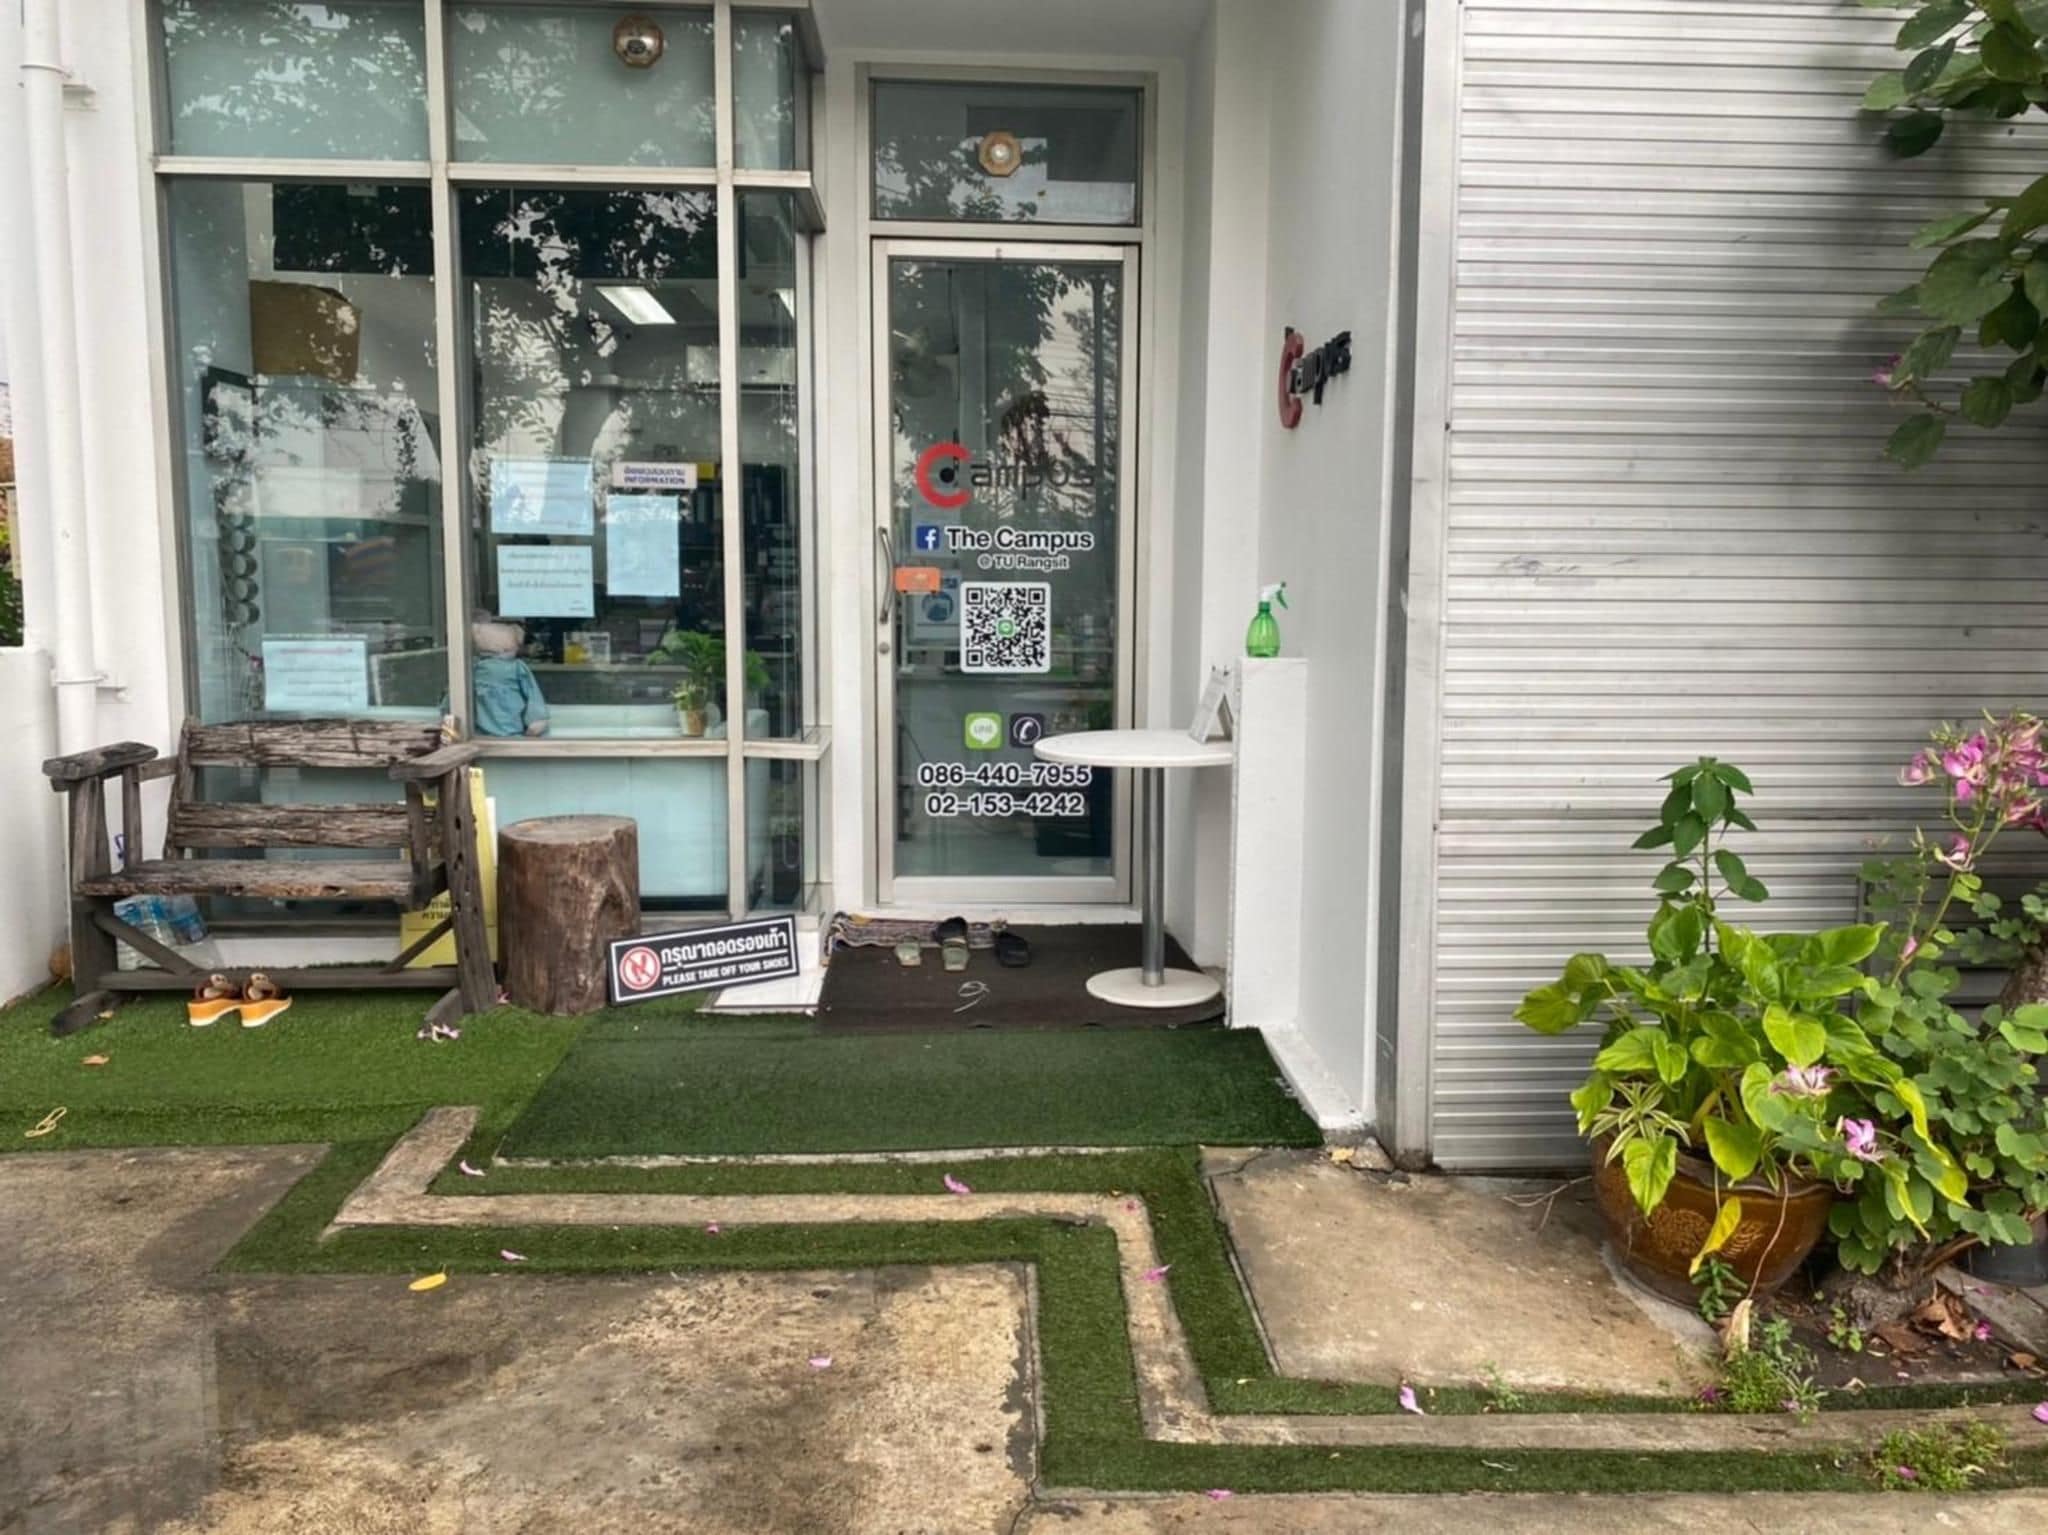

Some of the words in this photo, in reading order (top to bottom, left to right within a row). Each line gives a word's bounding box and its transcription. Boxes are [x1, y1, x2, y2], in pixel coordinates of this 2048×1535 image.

[624, 476, 685, 485] INFORMATION
[946, 527, 991, 549] The
[996, 527, 1093, 553] Campus
[1016, 555, 1069, 572] Rangsit
[919, 763, 1091, 785] 086-440-7955
[927, 794, 1083, 815] 02-153-4242
[661, 927, 787, 967] กรุณาถอดรองเท้า
[662, 971, 697, 986] PLEASE
[698, 967, 720, 980] TAKE
[720, 964, 738, 977] OFF
[739, 961, 762, 974] YOUR
[762, 956, 790, 970] SHOES
